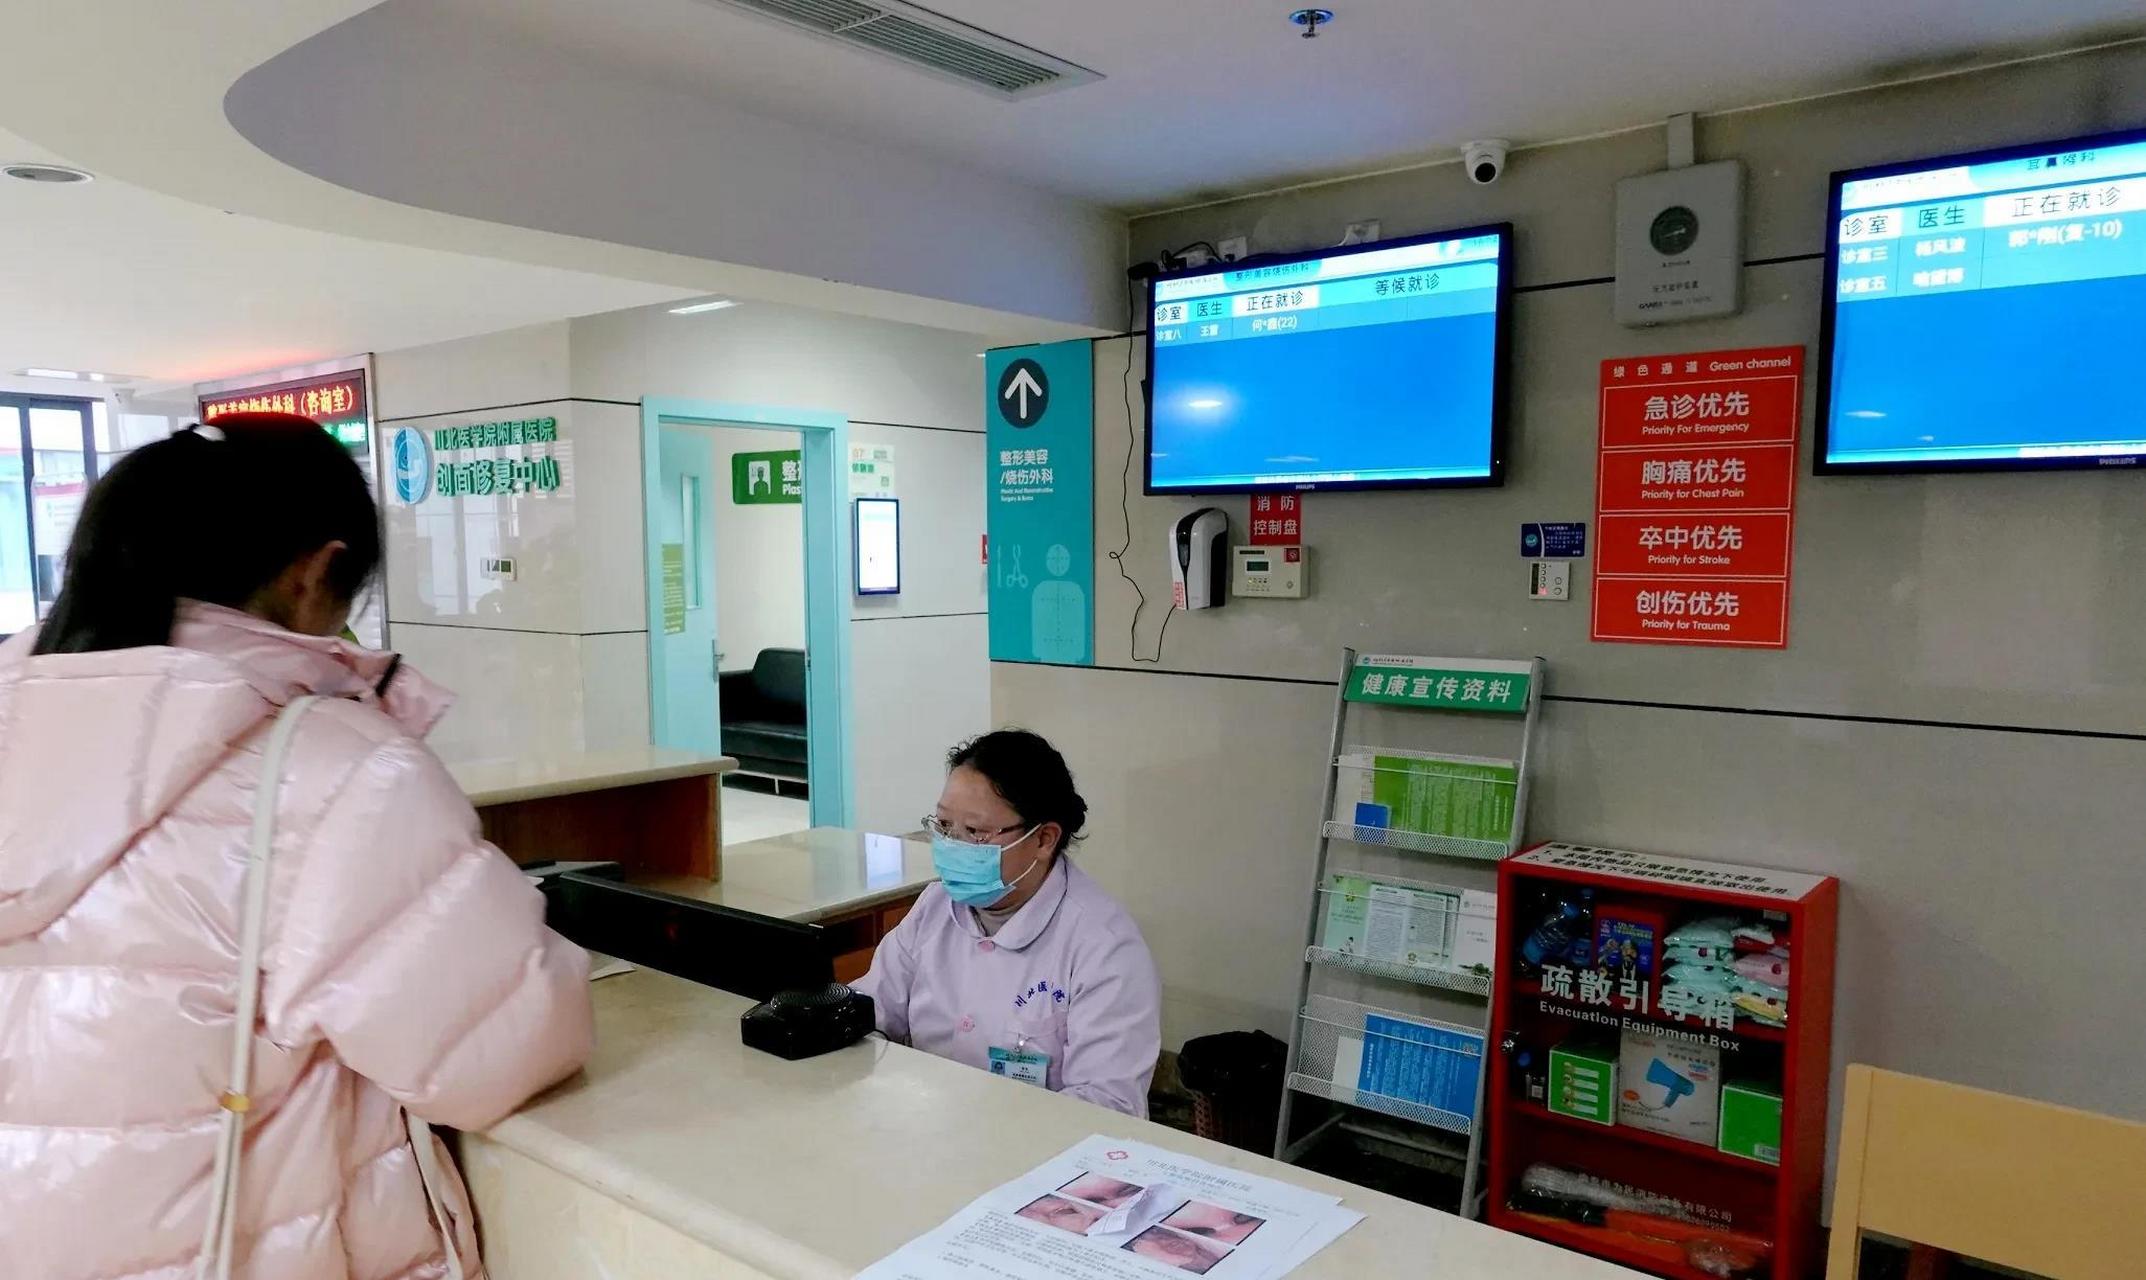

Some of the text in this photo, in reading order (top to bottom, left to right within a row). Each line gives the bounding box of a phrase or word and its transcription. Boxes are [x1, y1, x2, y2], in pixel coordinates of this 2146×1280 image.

[1845, 186, 2121, 236] 诊室 医生 正在就诊
[1375, 273, 1439, 296] 等候就诊
[1157, 290, 1303, 321] 诊室 医生 正在就诊
[1613, 356, 1792, 378] 绿色通道 Green channel
[1643, 392, 1749, 421] 急诊优先
[434, 416, 557, 450] 川北医学院附属医院
[1642, 422, 1750, 435] Priority For Emergency
[1000, 449, 1049, 466] 整形美容
[436, 455, 561, 497] 创面修复中心
[782, 459, 801, 482] 整
[1000, 468, 1054, 485] /烧伤外科
[1641, 458, 1747, 485] 胸痛优先
[1257, 496, 1295, 512] 消防
[1641, 487, 1745, 500] Priority for Chest Pain
[1253, 519, 1298, 536] 控制盘
[1639, 525, 1743, 550] 卒中优先
[1647, 554, 1731, 565] Priority for Stroke
[1636, 590, 1740, 616] 创伤优先
[1641, 619, 1731, 631] Priority for Trauma
[1362, 672, 1511, 703] 健康宣传资料
[1540, 963, 1735, 1031] 疏散引导箱
[1539, 1000, 1740, 1052] Evacuation Equipment Box
